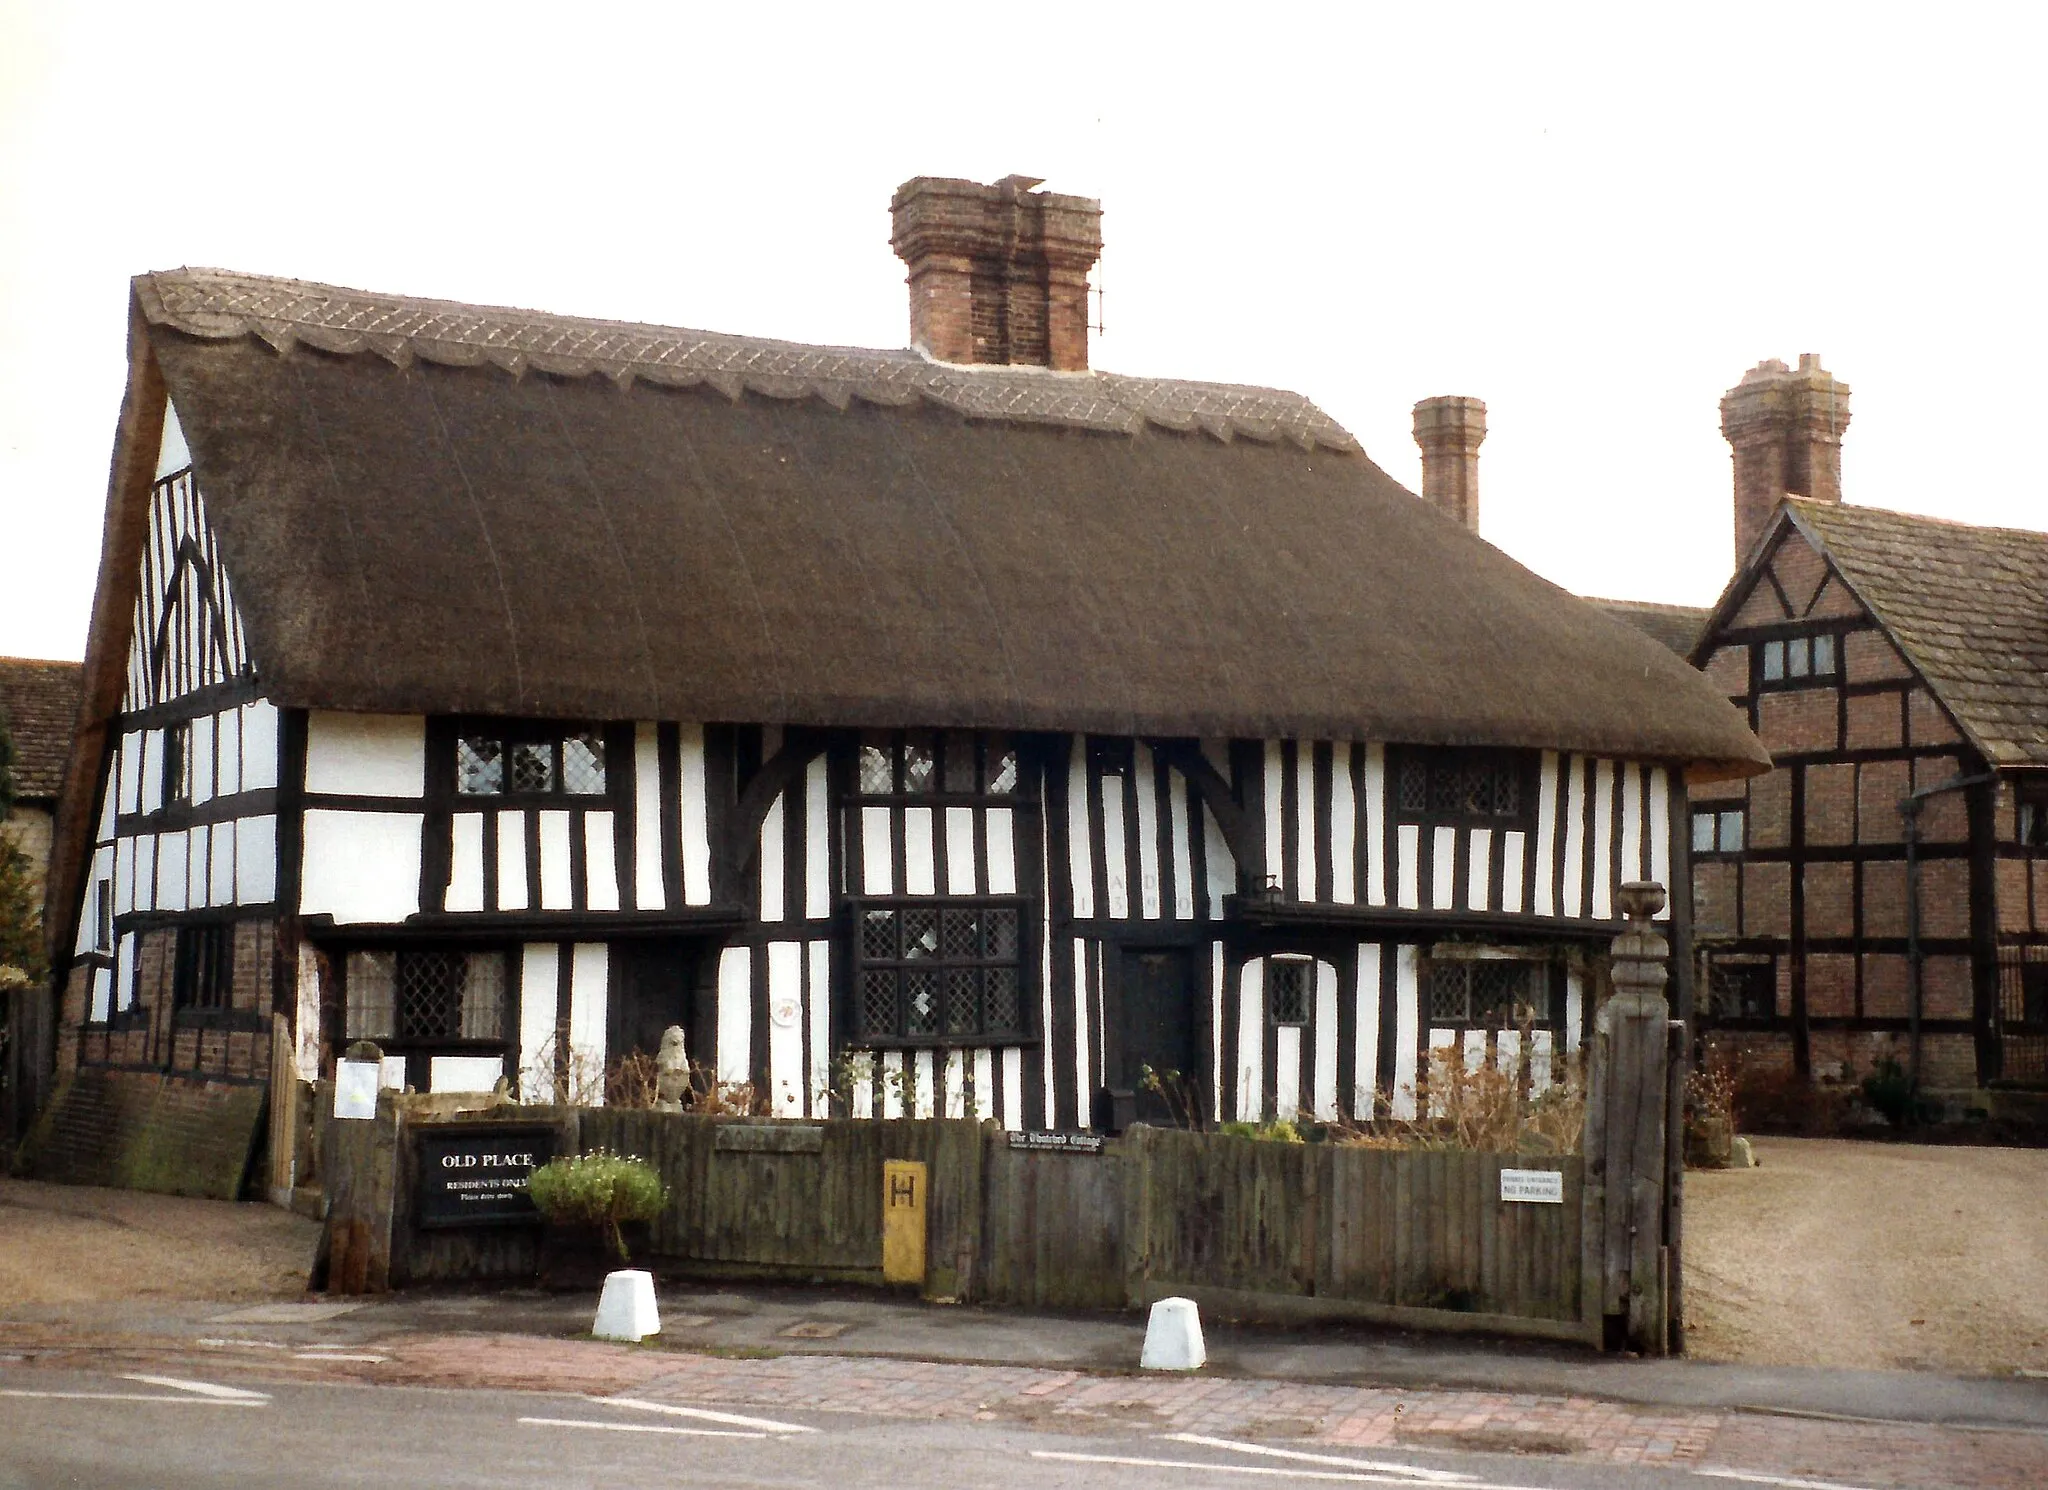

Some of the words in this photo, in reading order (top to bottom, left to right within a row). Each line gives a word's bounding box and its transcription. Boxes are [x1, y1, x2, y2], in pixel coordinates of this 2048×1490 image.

[1111, 875, 1123, 890] A
[1144, 874, 1156, 890] D
[441, 1155, 477, 1168] OLD
[482, 1153, 533, 1167] PLACE
[446, 1179, 500, 1190] RESIDENTS
[502, 1178, 528, 1188] ONLY
[891, 1174, 914, 1208] H
[1503, 1185, 1517, 1195] NO
[1519, 1186, 1558, 1196] PARKING
